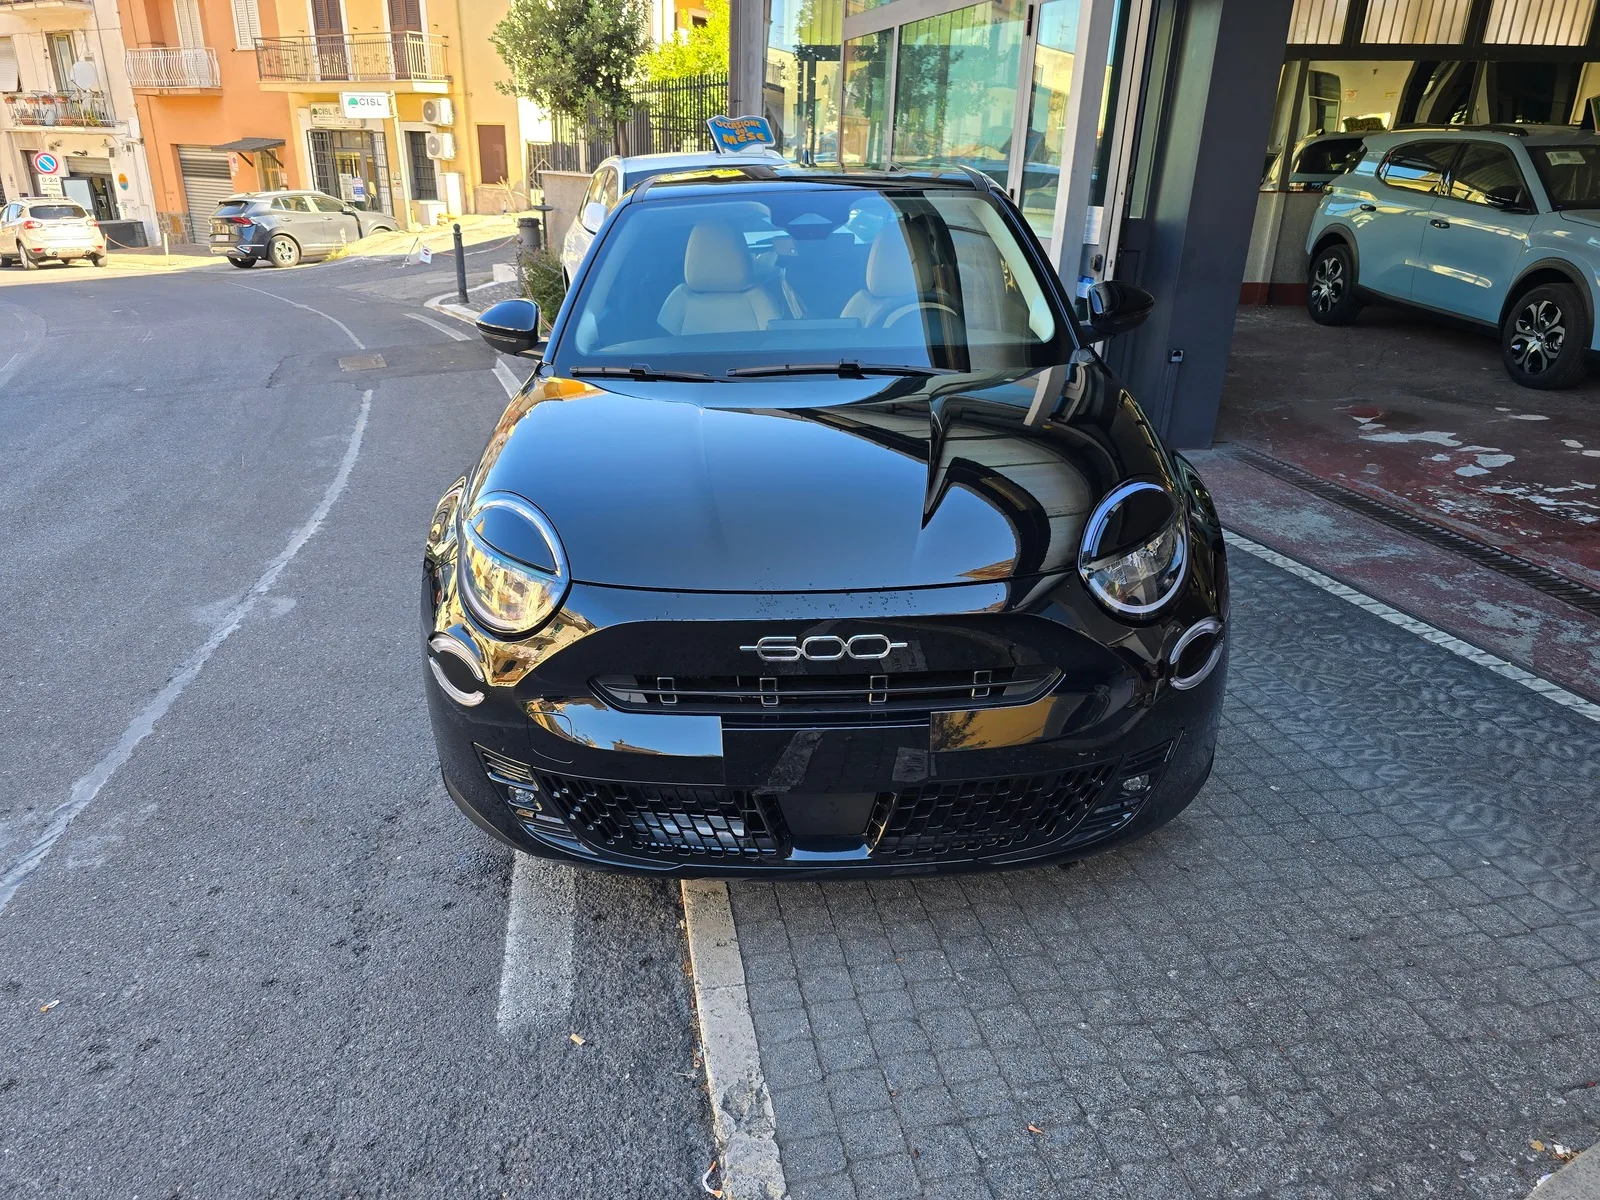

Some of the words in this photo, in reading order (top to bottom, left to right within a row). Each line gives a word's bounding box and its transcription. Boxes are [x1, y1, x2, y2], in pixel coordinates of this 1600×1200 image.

[359, 98, 382, 106] CISL
[318, 107, 333, 116] CISL
[756, 634, 892, 661] 600
